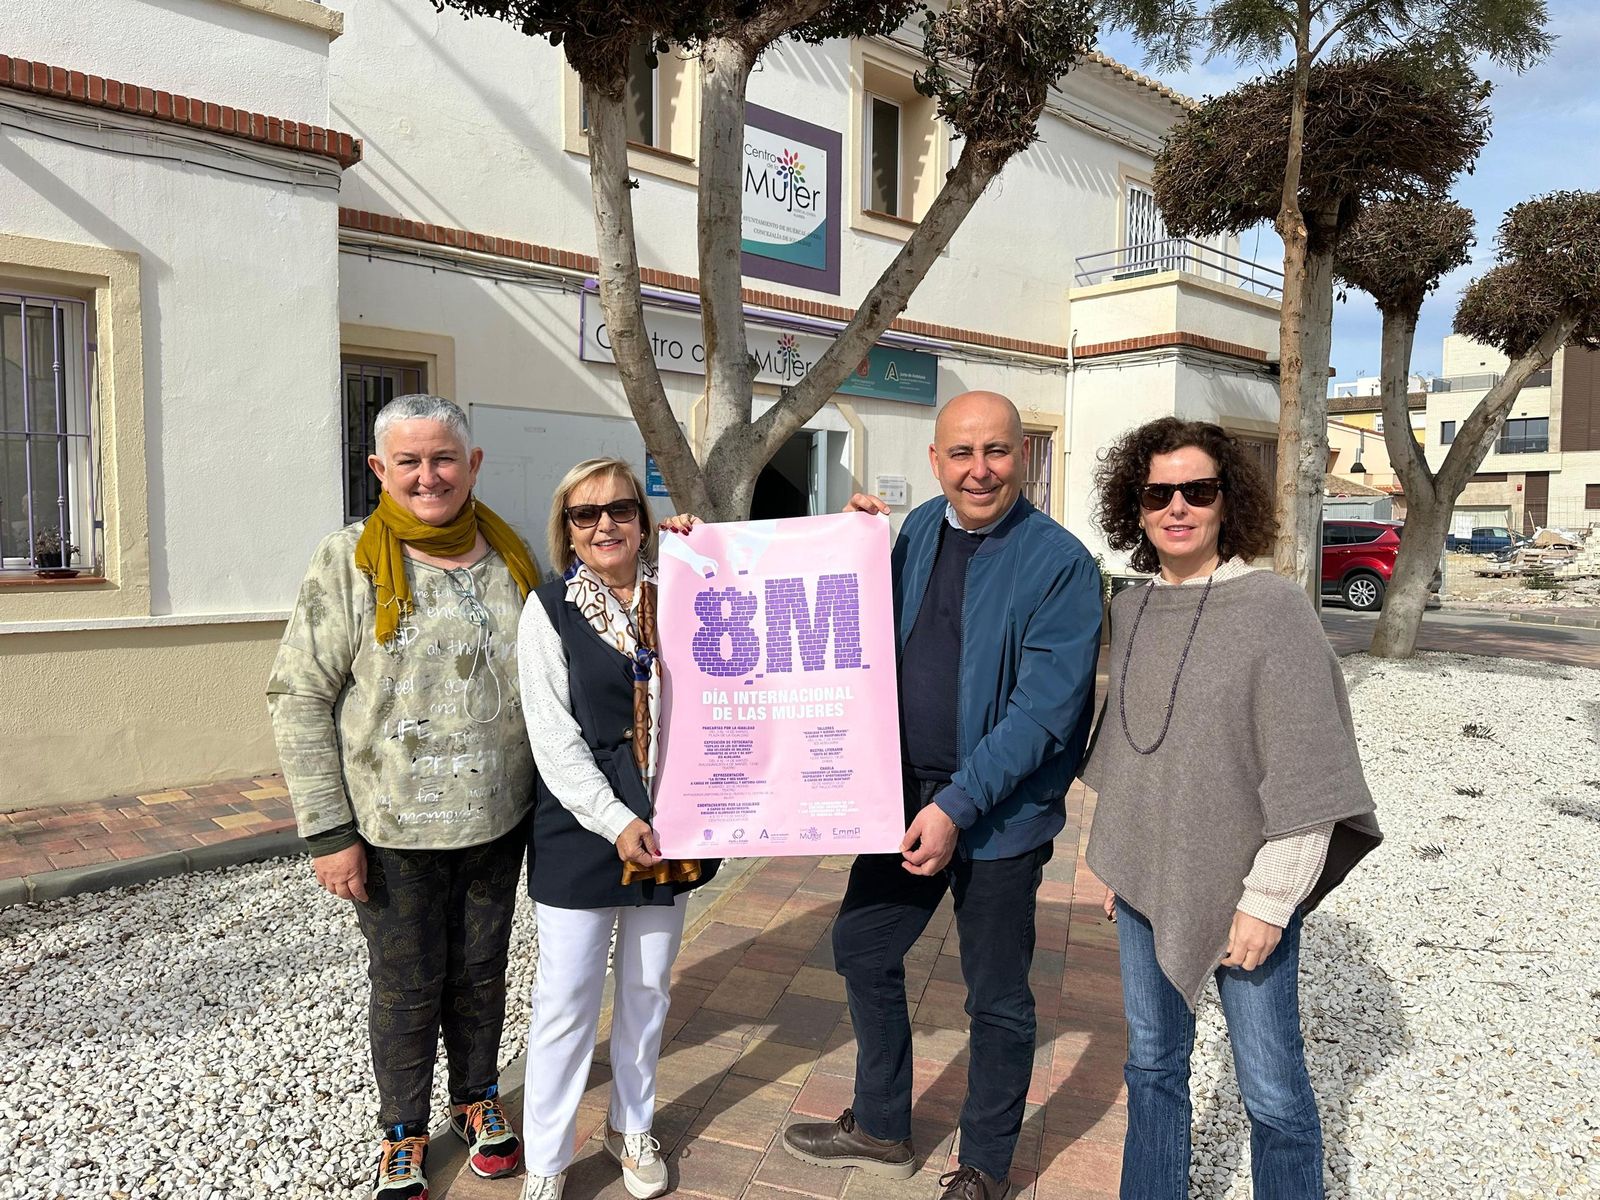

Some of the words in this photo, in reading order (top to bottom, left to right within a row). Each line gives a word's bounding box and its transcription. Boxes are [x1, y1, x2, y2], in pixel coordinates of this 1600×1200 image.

[744, 143, 777, 163] Centro
[745, 163, 820, 212] Mujer
[596, 323, 683, 360] Ctro
[755, 346, 812, 381] Mujer
[692, 573, 862, 677] 8M
[702, 688, 729, 705] DÍA
[733, 686, 855, 704] INTERNACIONAL
[713, 706, 732, 721] DE
[737, 705, 767, 720] LAS
[772, 702, 844, 720] MUJERES
